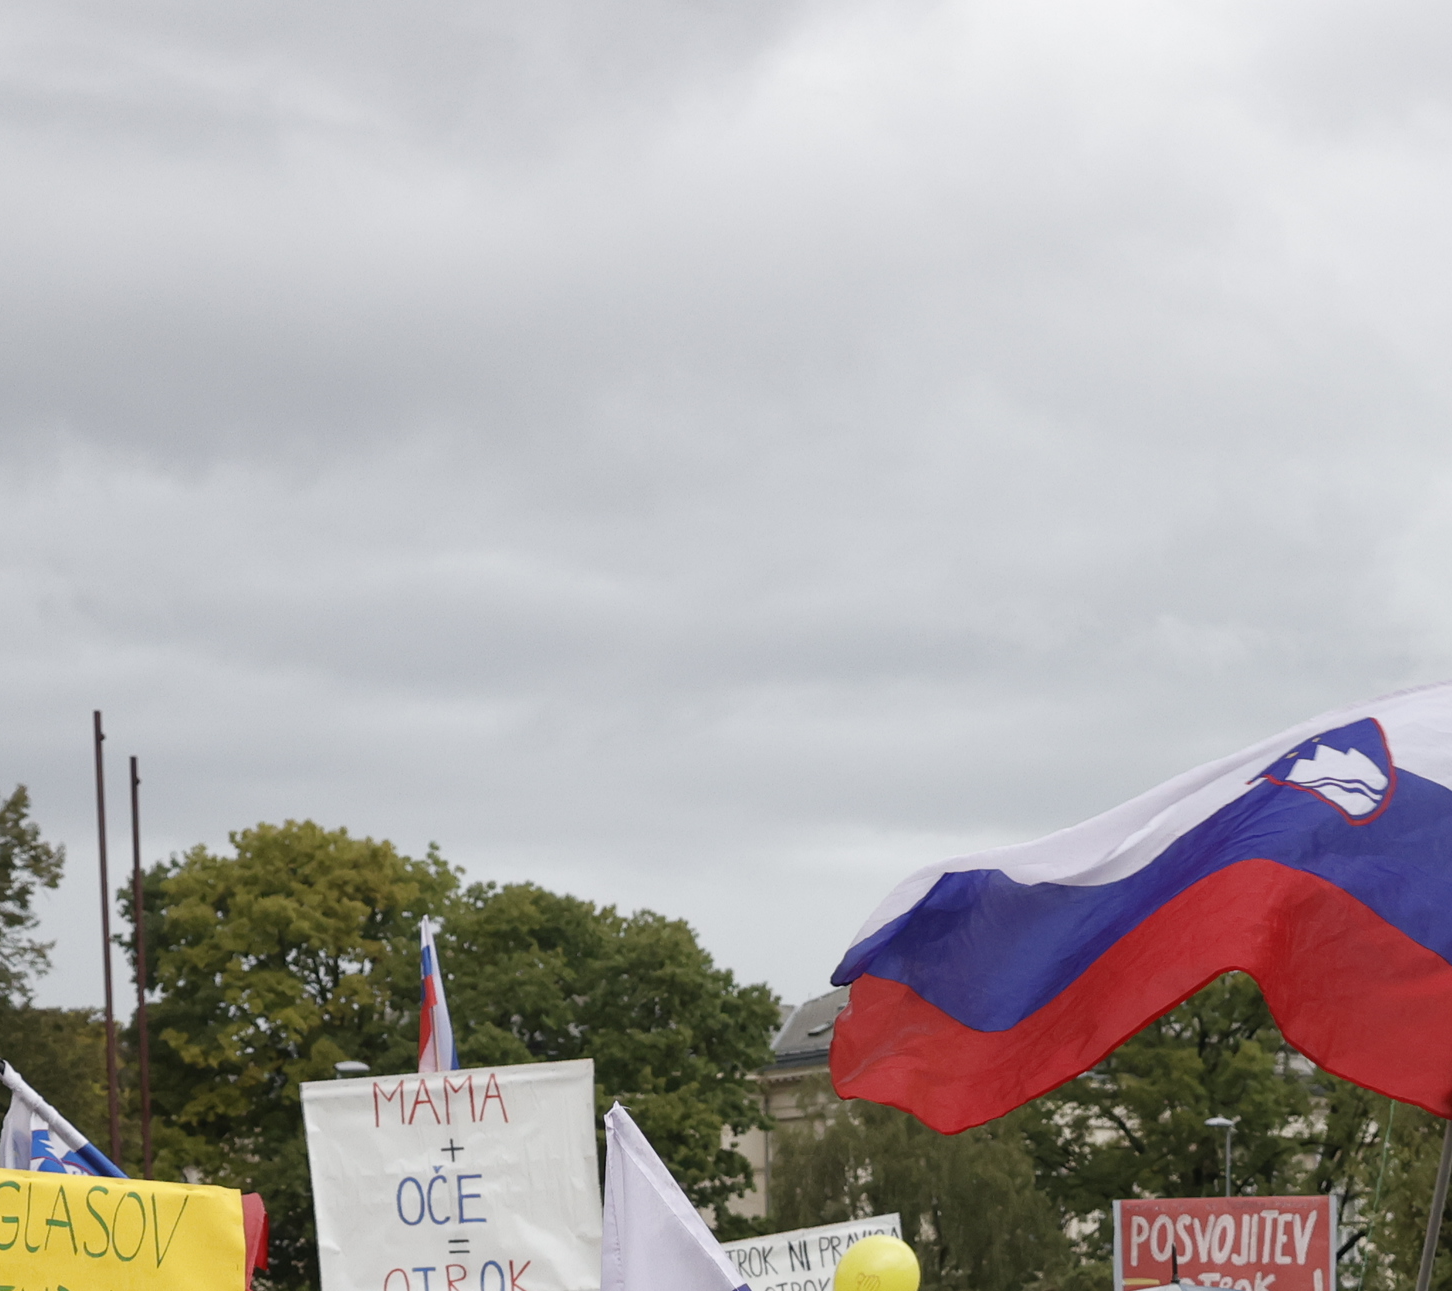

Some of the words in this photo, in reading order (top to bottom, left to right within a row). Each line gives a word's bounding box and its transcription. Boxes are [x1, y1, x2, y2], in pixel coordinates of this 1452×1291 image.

[372, 1073, 509, 1128] MAMA
[396, 1165, 488, 1227] OČE
[727, 1245, 778, 1279] TROK
[788, 1240, 812, 1272] NI
[1130, 1209, 1318, 1267] POSVOJITEV
